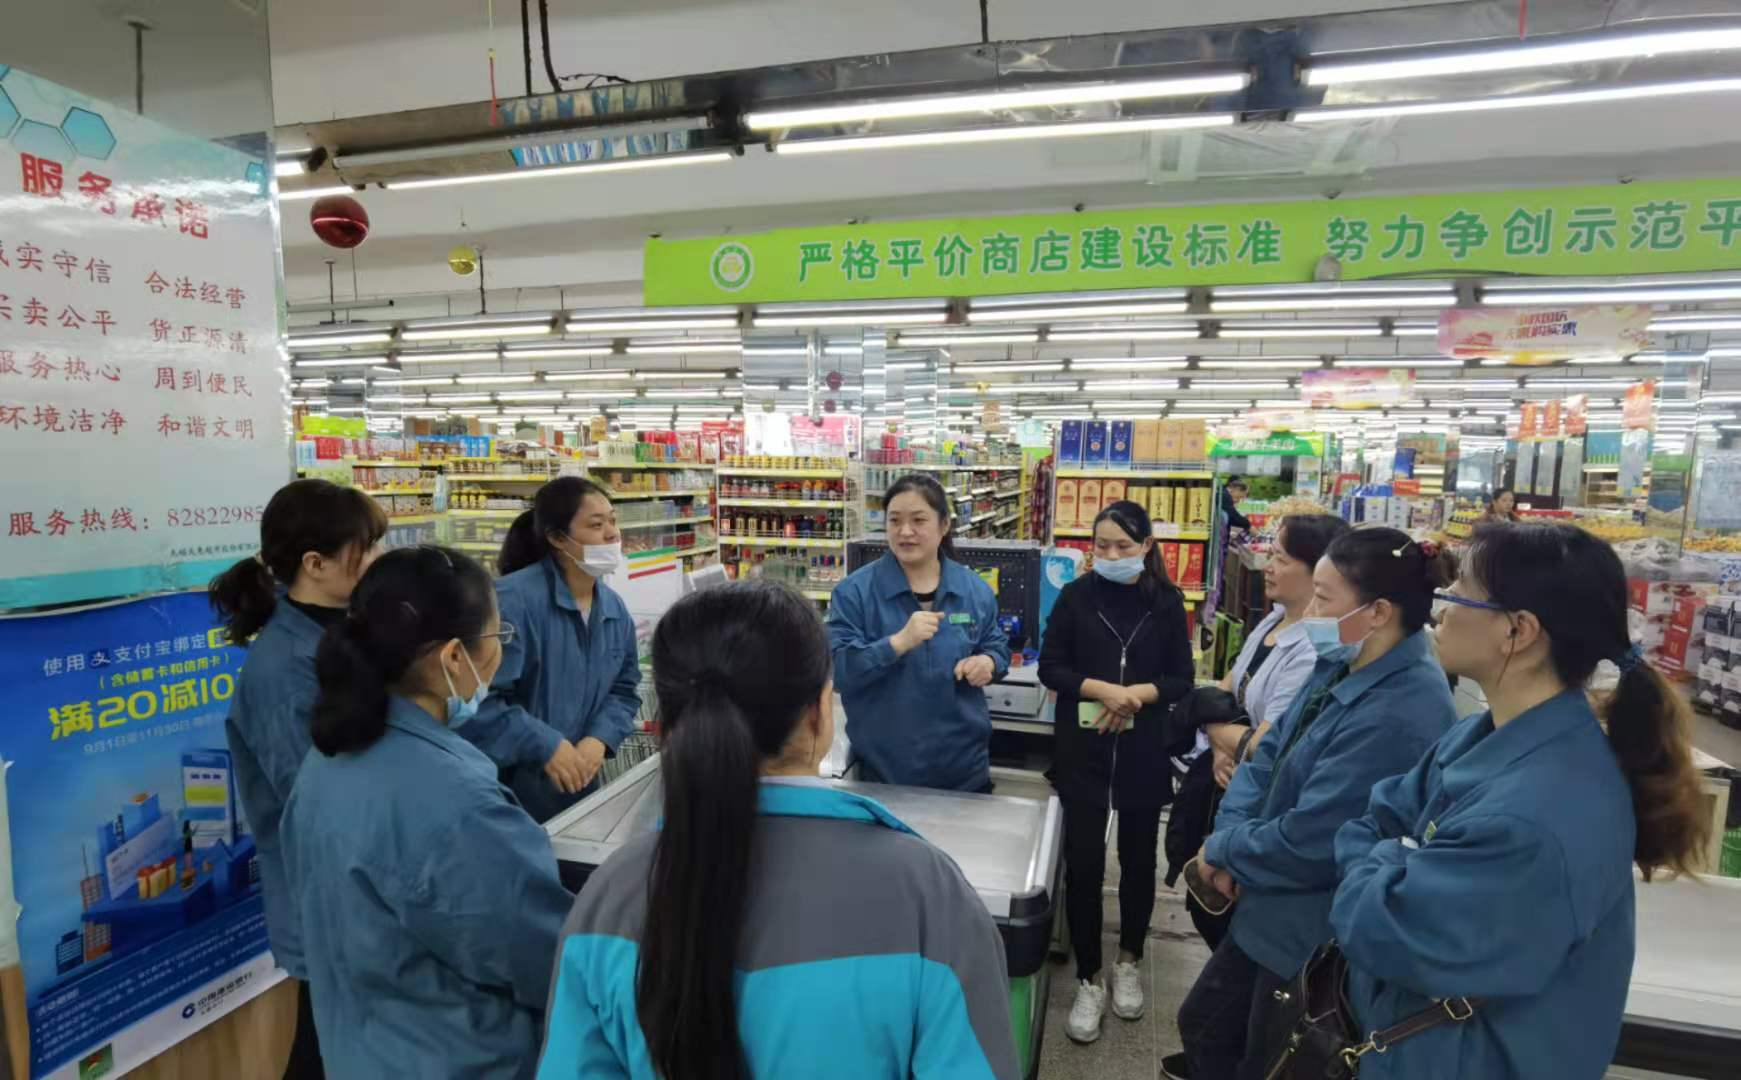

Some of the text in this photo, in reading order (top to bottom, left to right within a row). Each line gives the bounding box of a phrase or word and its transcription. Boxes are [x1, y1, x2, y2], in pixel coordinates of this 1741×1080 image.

[20, 152, 208, 239] 服务承诺
[799, 200, 1741, 283] 严格平价商店建设标准 努力争创示范平
[144, 269, 246, 309] 合法经营
[149, 317, 248, 355] 货正源清
[0, 351, 120, 382] 服务热心
[154, 366, 252, 397] 周到便民
[0, 404, 127, 436] 环境洁净
[157, 413, 255, 440] 和谐文明
[167, 505, 264, 527] 82822985
[47, 667, 243, 741] 满20减10
